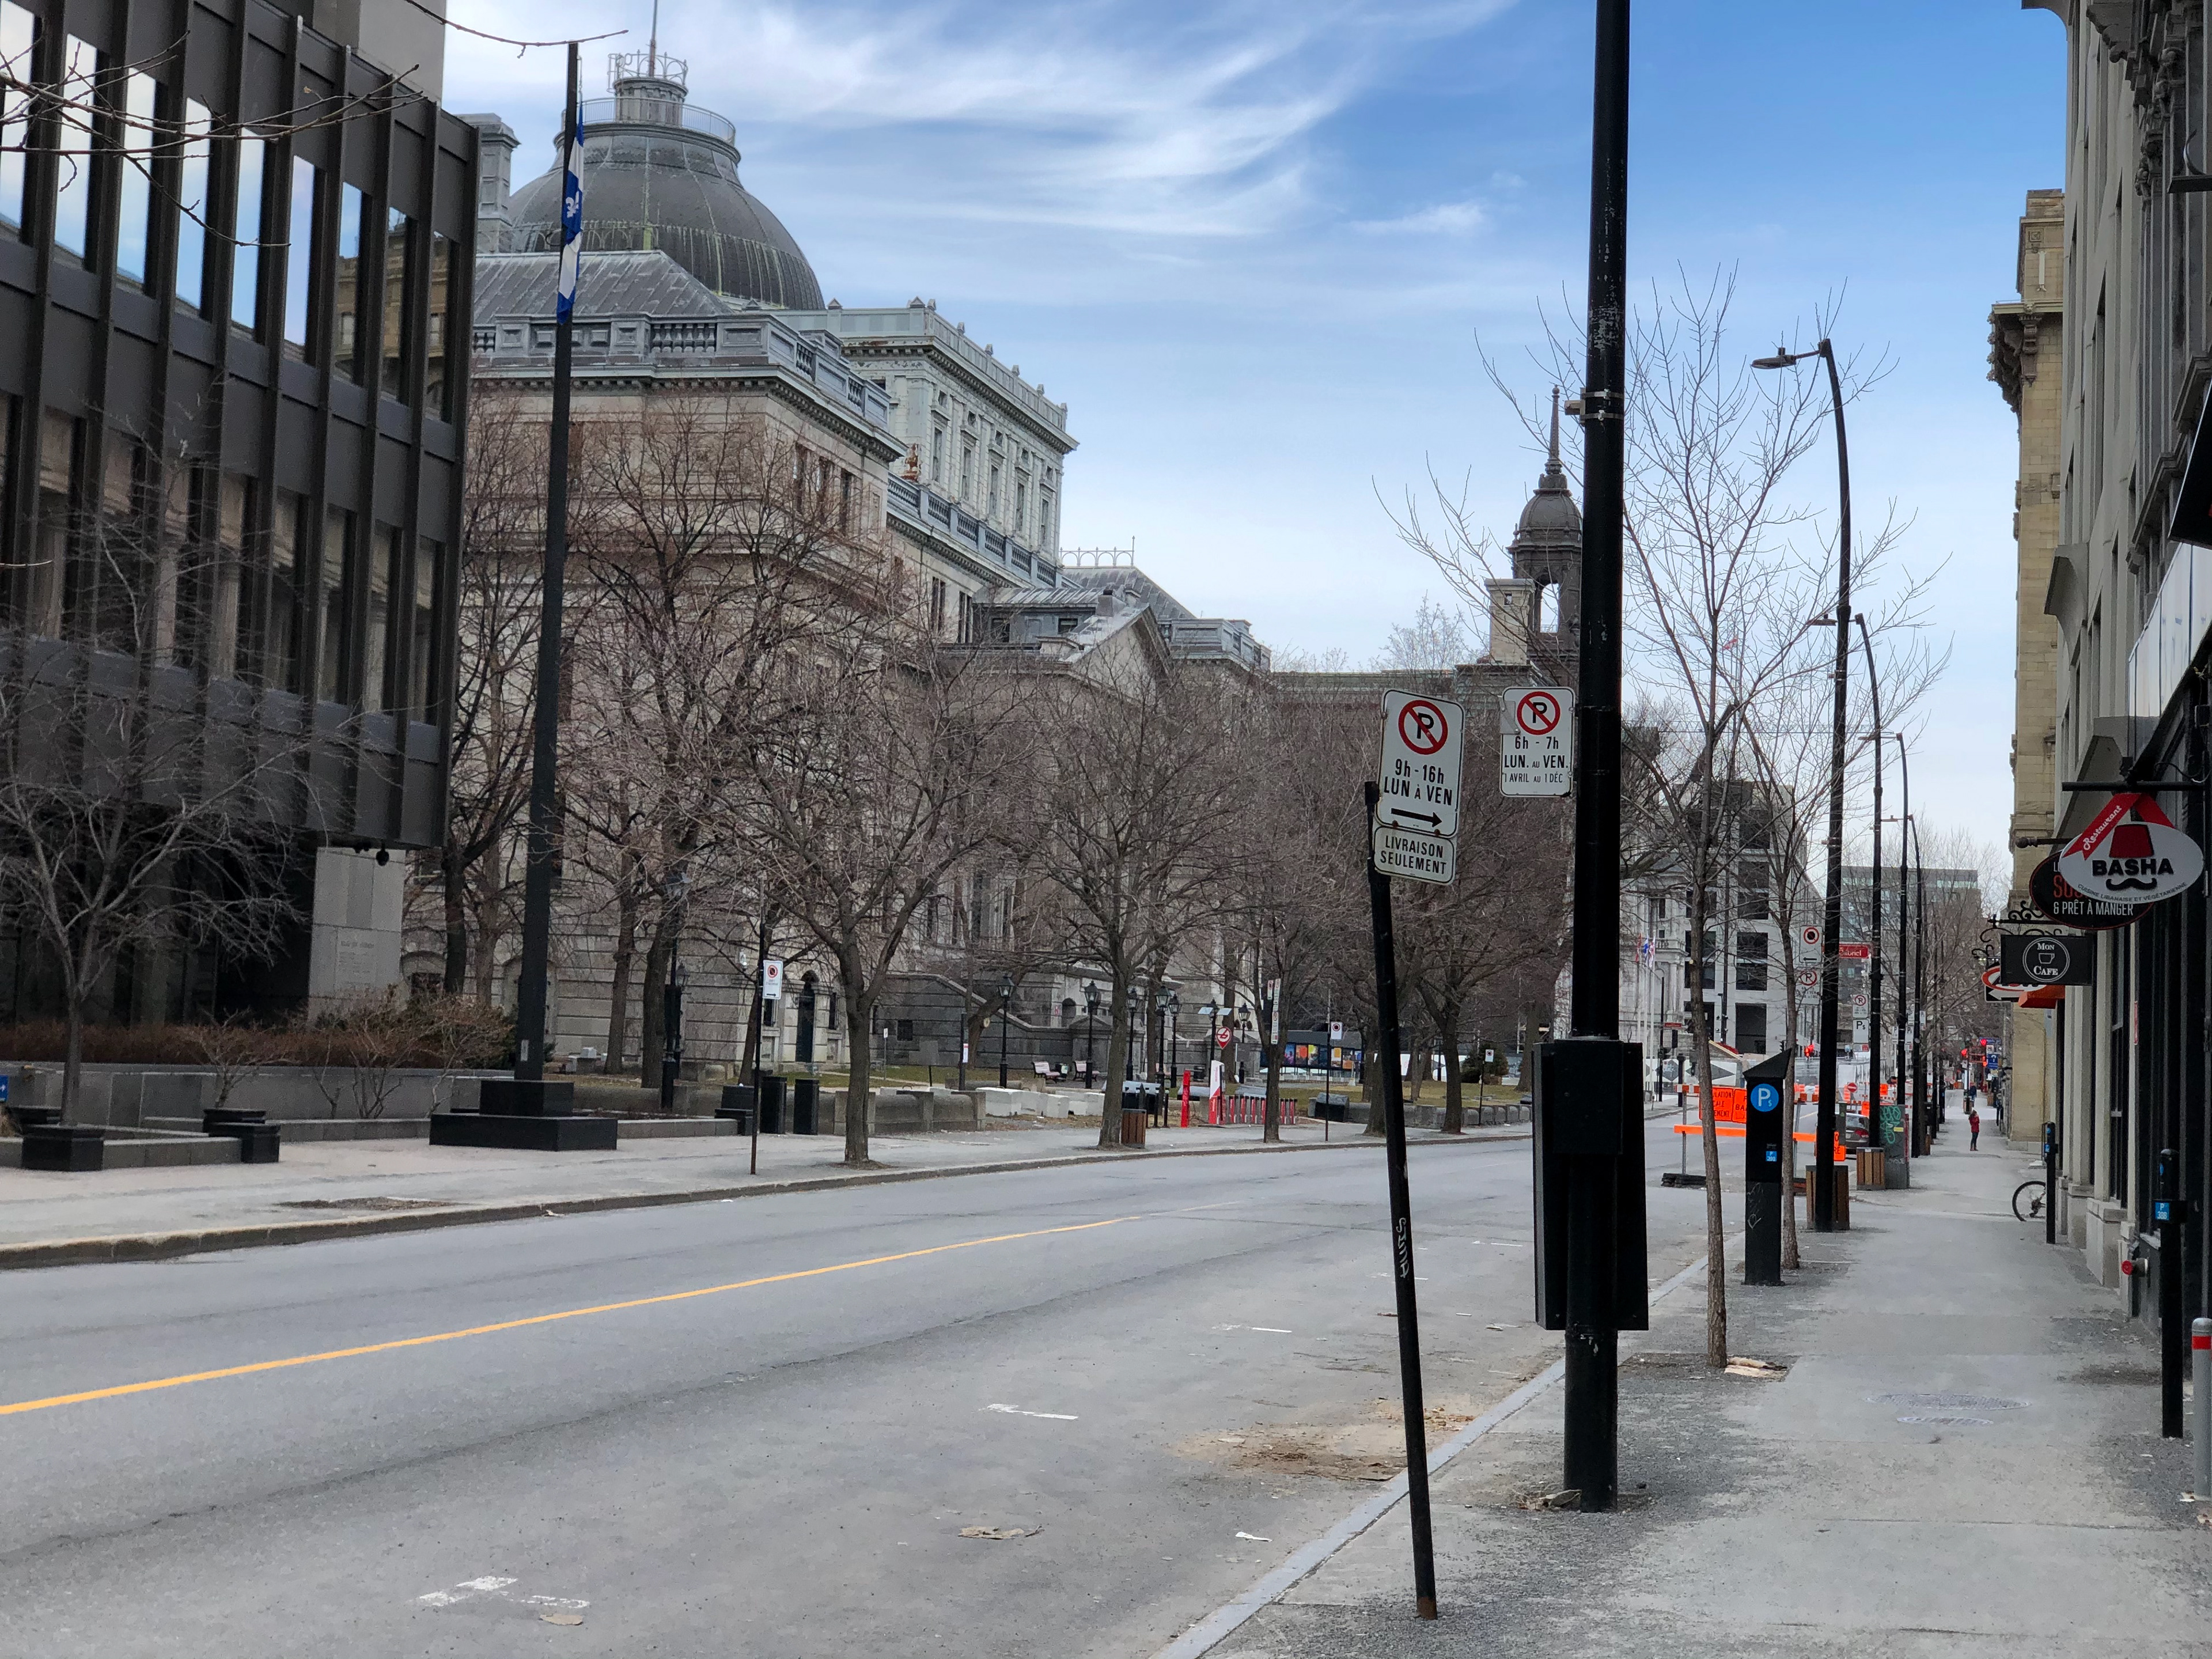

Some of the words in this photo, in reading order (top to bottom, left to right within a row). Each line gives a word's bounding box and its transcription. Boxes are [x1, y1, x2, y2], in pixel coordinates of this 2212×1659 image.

[1515, 736, 1529, 749] 6h
[1546, 736, 1559, 749] 7h
[1395, 759, 1411, 777] 9h
[1423, 764, 1444, 784] 16h
[1504, 755, 1529, 768] LUN.
[1543, 755, 1569, 768] VEN.
[1509, 773, 1529, 782] AVRIL
[1384, 777, 1411, 797] LUN
[1427, 785, 1452, 806] VEN
[2083, 805, 2122, 850] Restaurant
[1385, 835, 1444, 858] LIVRAISON
[1380, 850, 1446, 874] SEULEMENT
[2092, 858, 2174, 876] BASHA
[2078, 884, 2100, 897] CUISINE
[2100, 894, 2132, 902] LIBANAISE
[2143, 882, 2187, 901] VÉGÉTARIENNE
[2062, 899, 2085, 915] PRÊT
[2087, 899, 2093, 915] À
[2096, 902, 2134, 916] MANGER
